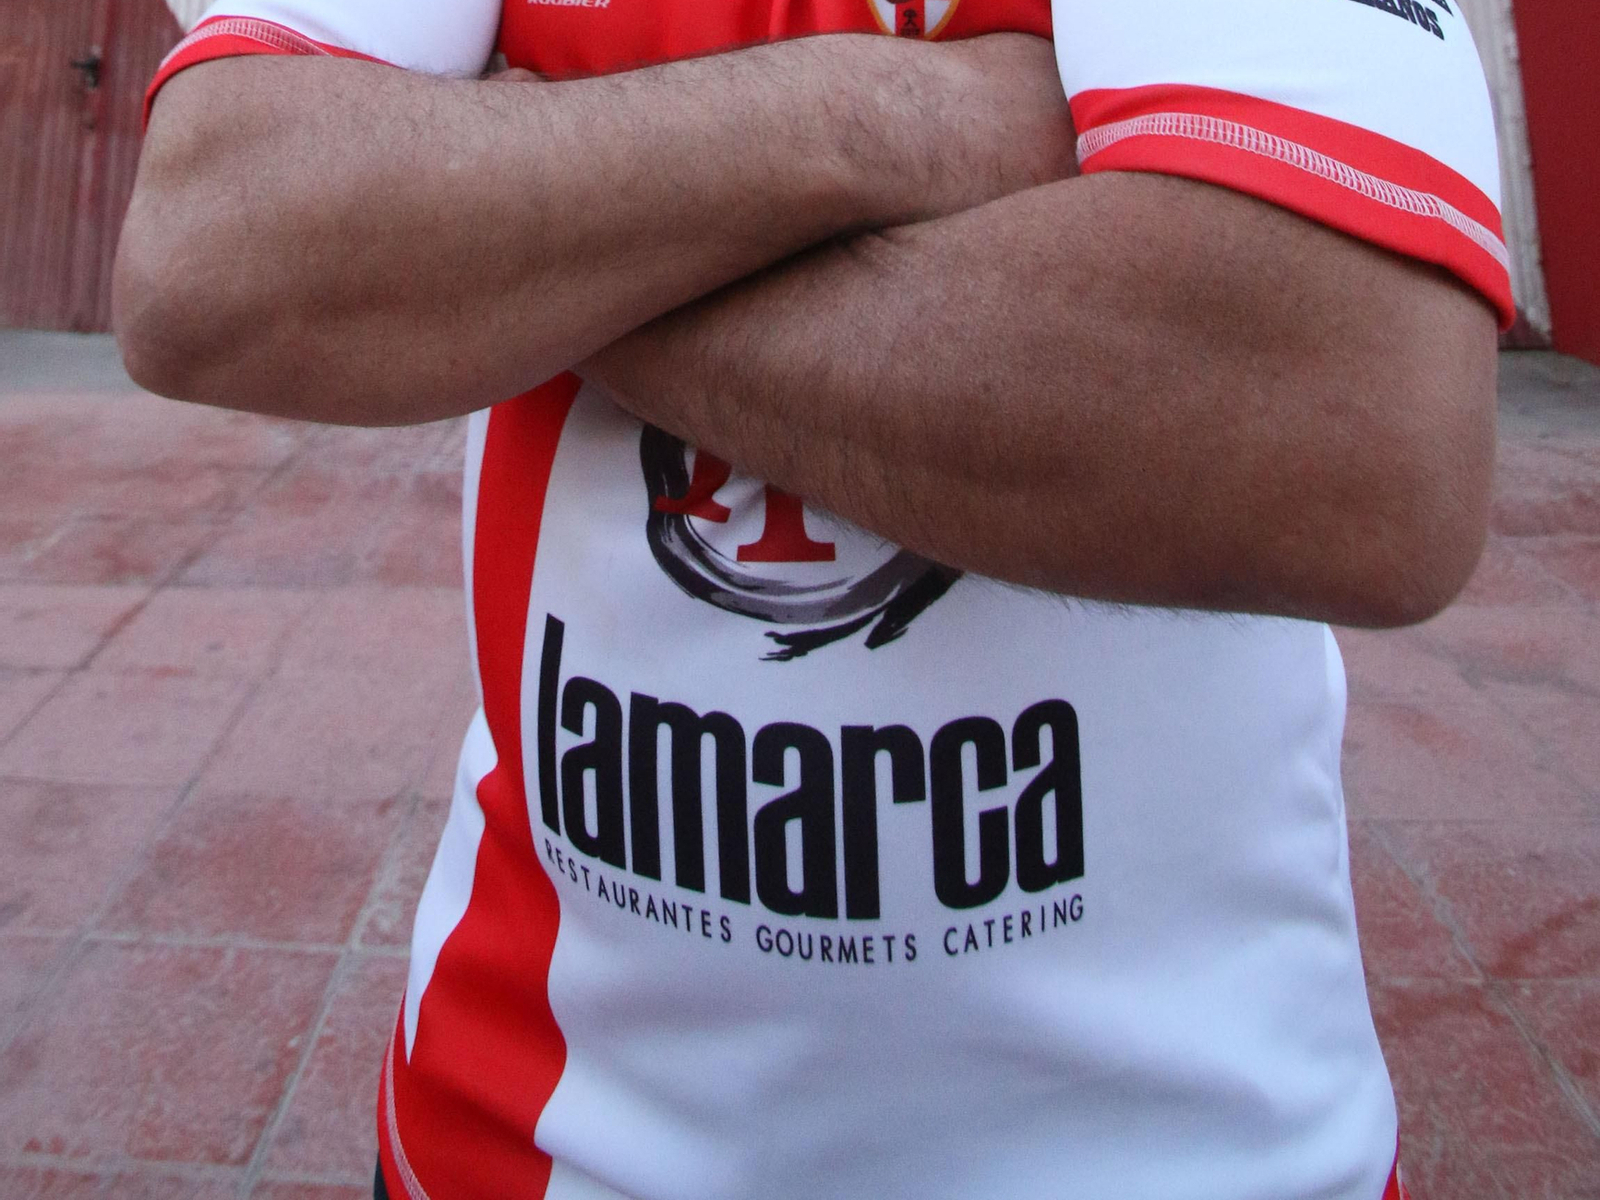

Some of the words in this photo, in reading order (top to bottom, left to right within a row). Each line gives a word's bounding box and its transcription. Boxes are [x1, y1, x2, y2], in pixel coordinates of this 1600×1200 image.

[537, 612, 1085, 920] lamarca
[544, 838, 732, 943] RESTAURANTES
[756, 924, 918, 964] GOURMETS
[943, 894, 1084, 956] CATERING
